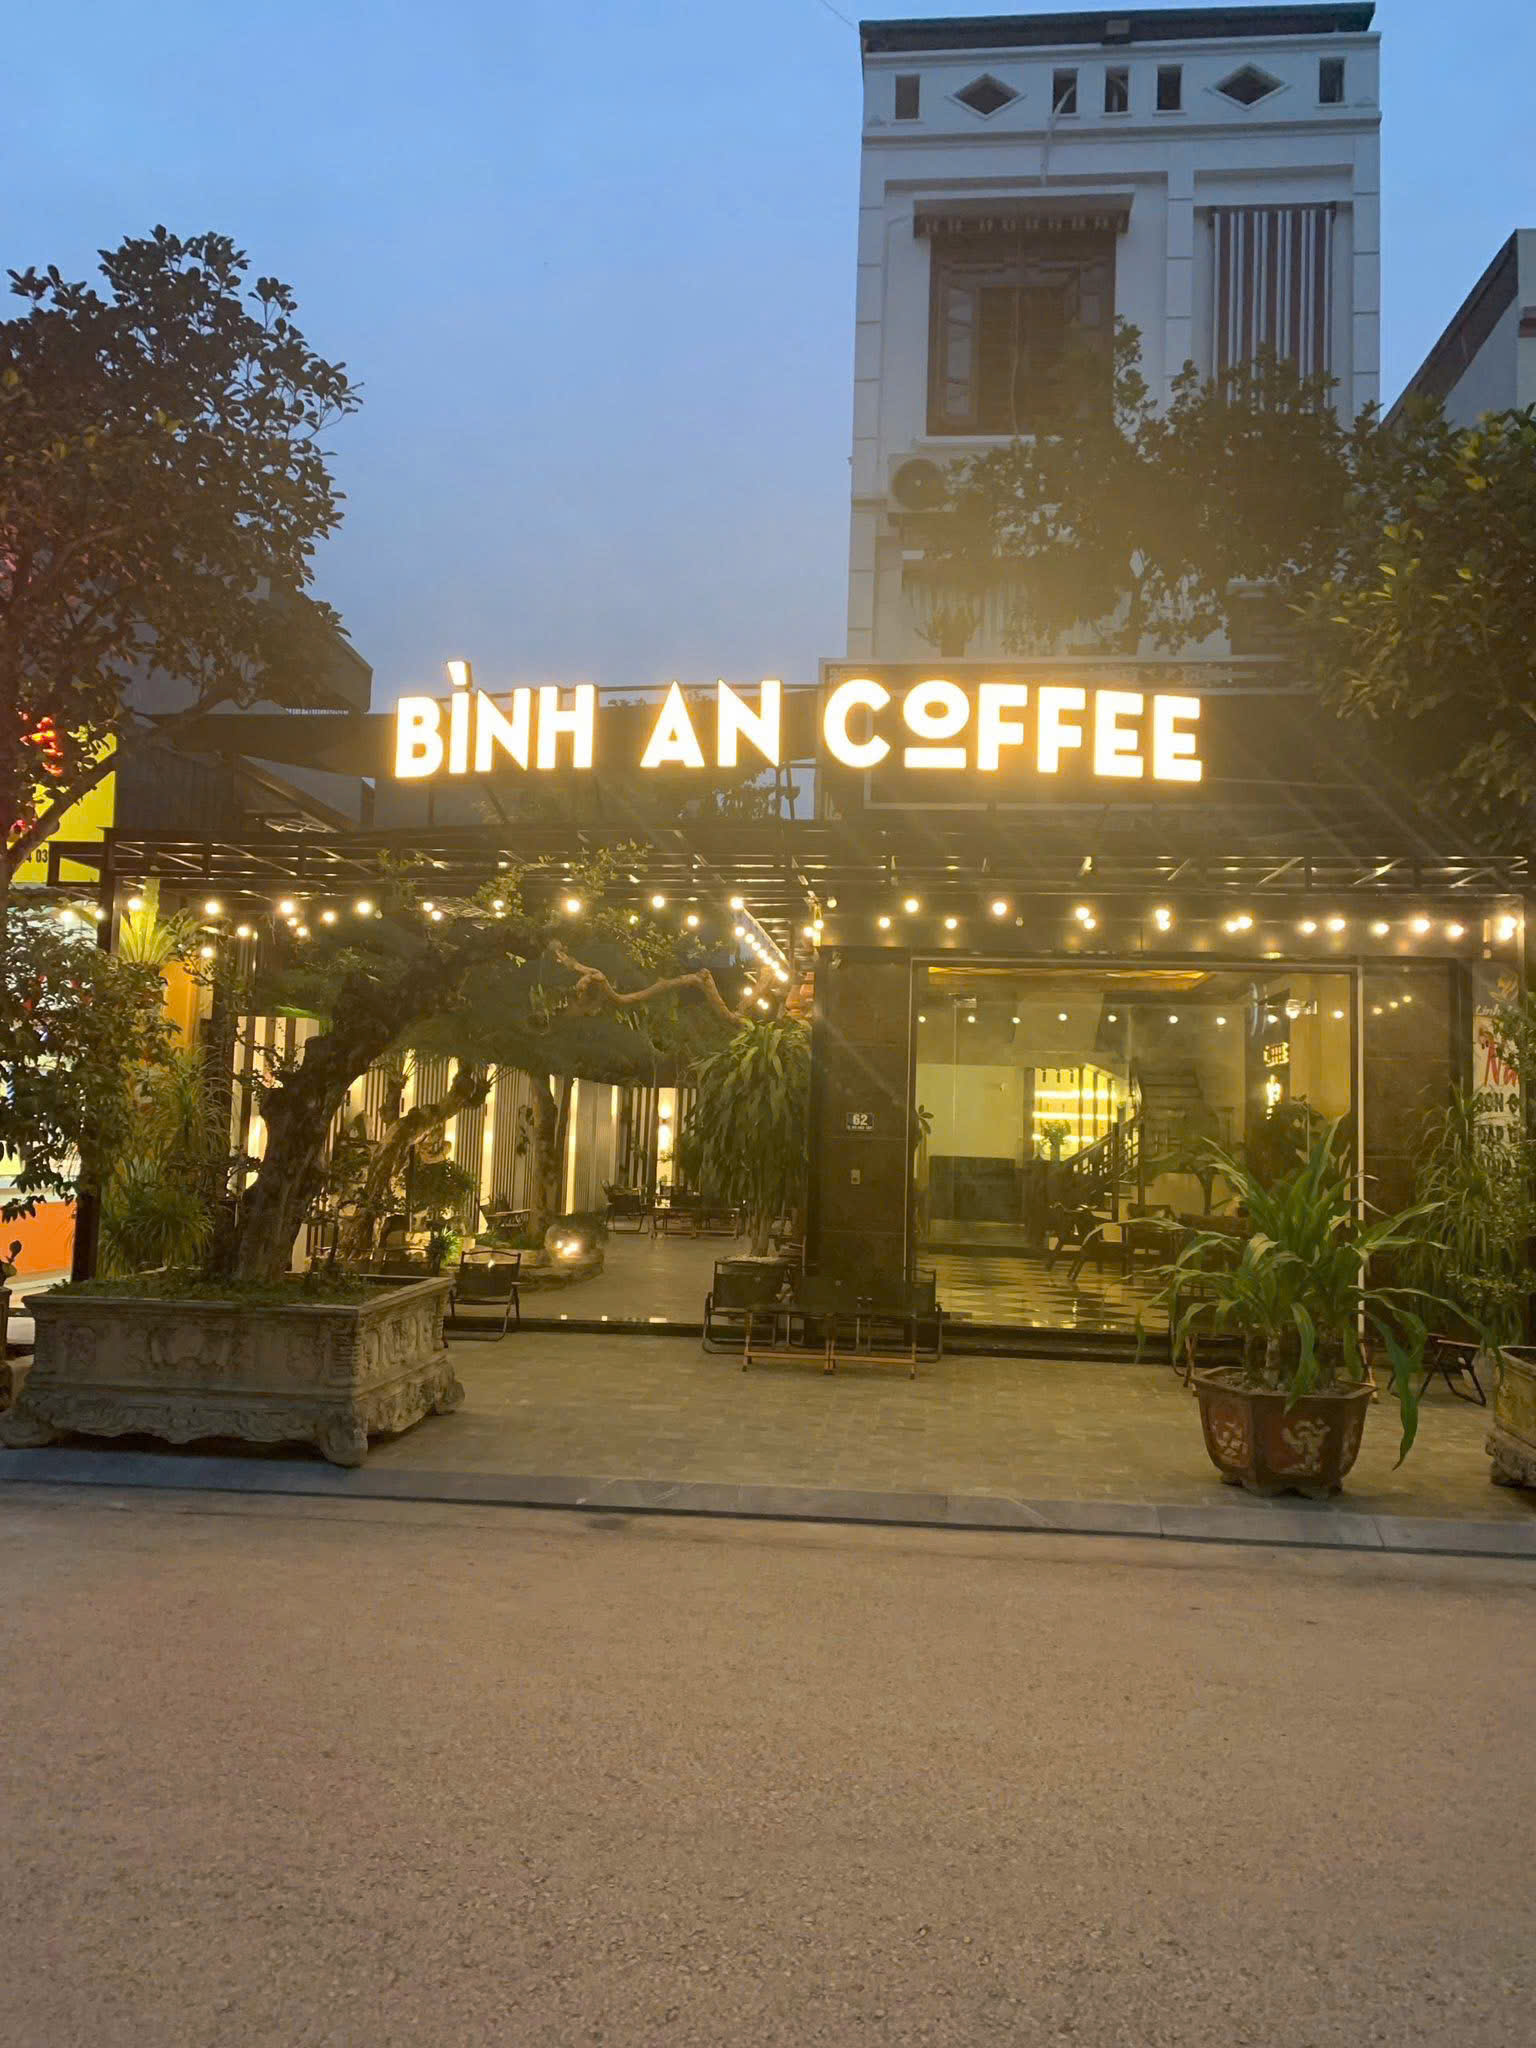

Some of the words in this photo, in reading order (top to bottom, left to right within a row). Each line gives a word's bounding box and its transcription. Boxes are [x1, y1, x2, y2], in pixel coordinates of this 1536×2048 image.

[394, 659, 597, 779] BÌNH
[639, 677, 782, 769] AN
[822, 678, 1203, 783] COFFEE
[852, 1112, 868, 1126] 62
